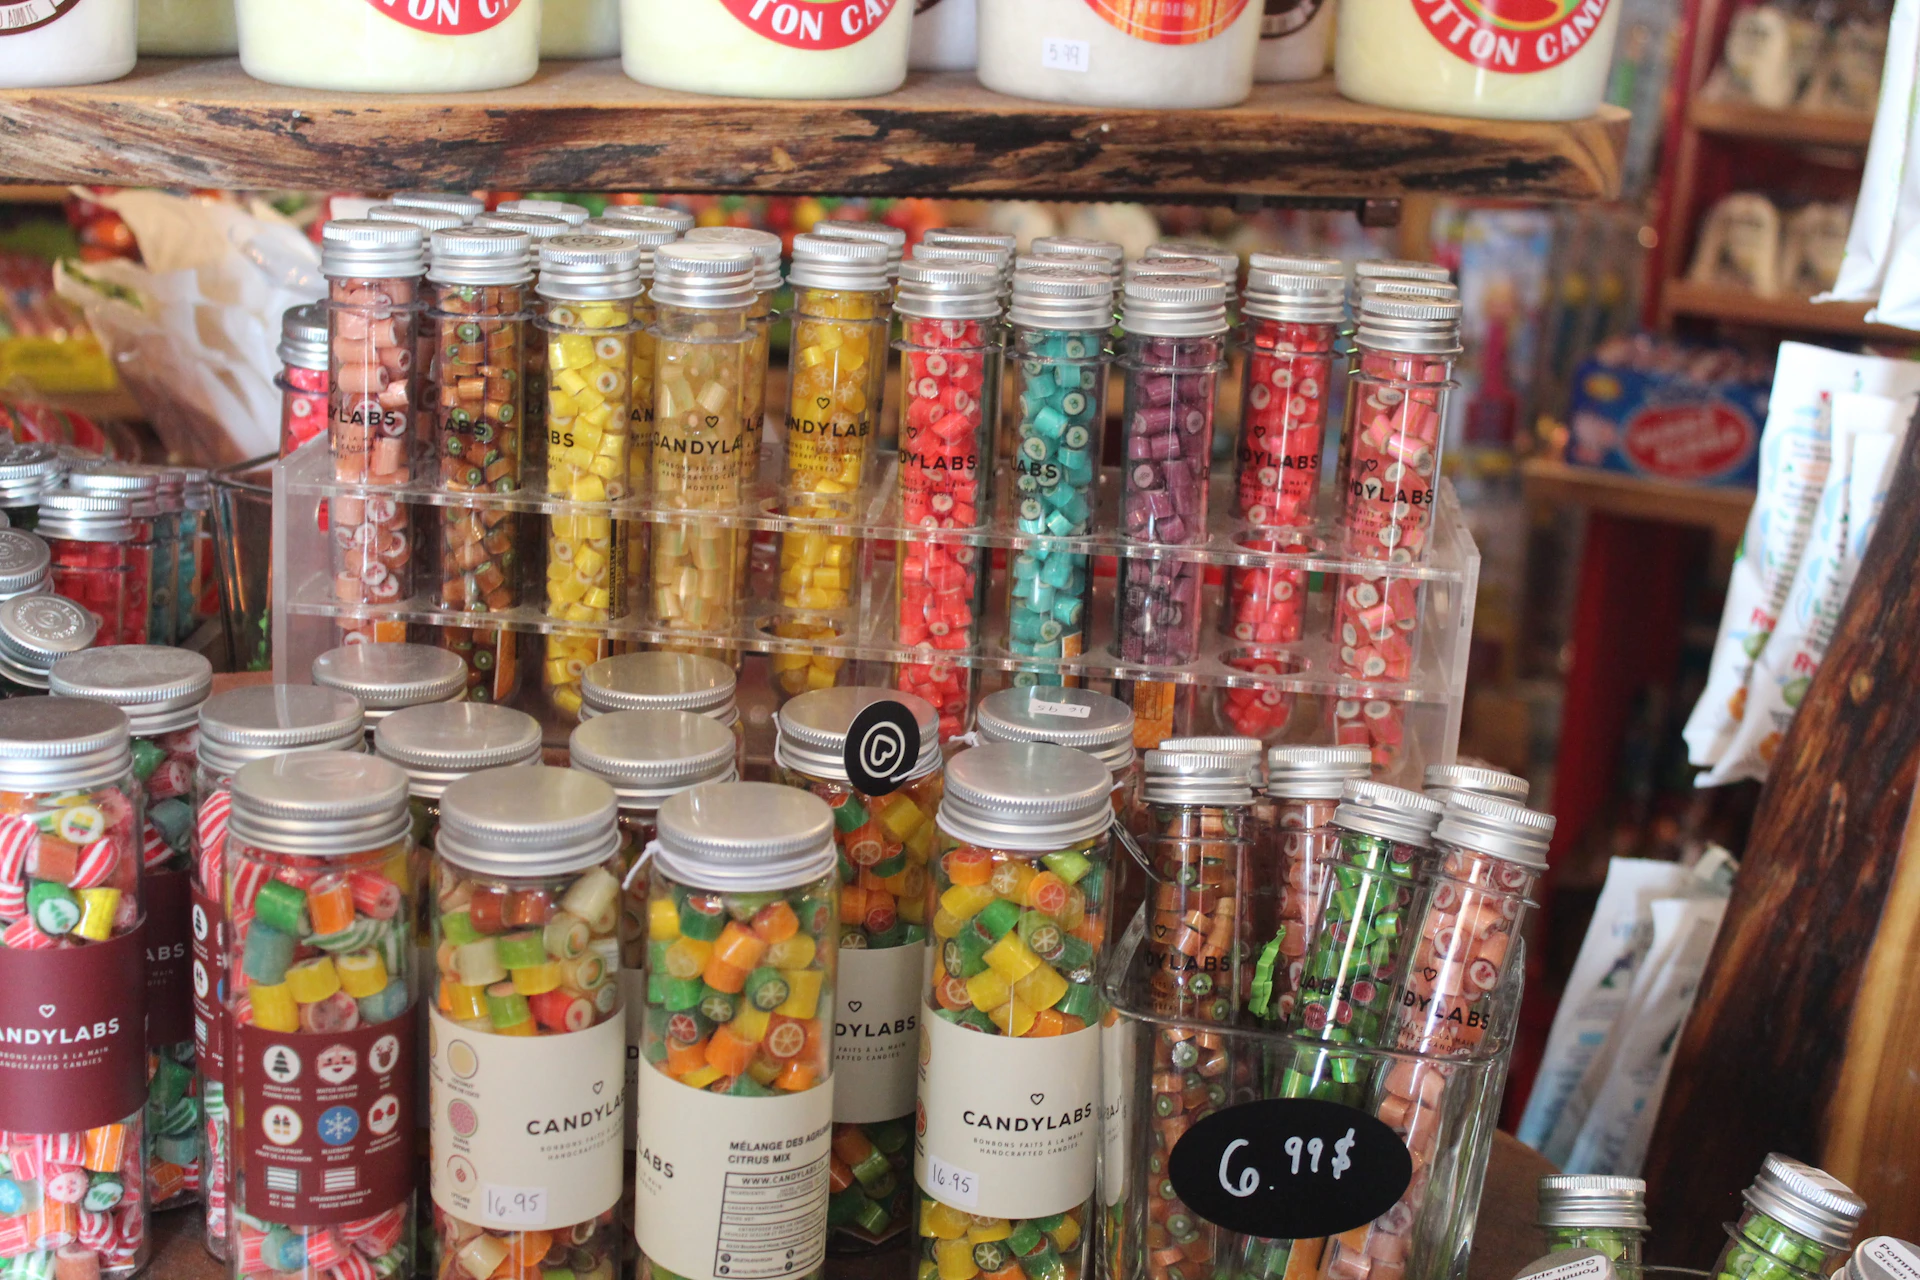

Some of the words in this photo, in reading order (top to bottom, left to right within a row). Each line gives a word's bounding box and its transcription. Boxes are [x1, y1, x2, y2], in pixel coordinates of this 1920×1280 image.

[1418, 0, 1521, 66] TTON
[962, 1102, 1092, 1132] CANDYLABS
[729, 1140, 783, 1152] MÉLANGE
[786, 1136, 804, 1149] DES
[973, 1137, 1016, 1148] BONBONS
[1055, 1138, 1064, 1146] LA
[979, 1148, 1044, 1157] HANDCRAFTED
[1047, 1141, 1079, 1155] CANDIES
[728, 1154, 770, 1165] CITRUS
[772, 1152, 791, 1164] MIX
[932, 1163, 973, 1194] 16.95
[488, 1190, 540, 1216] 16.95
